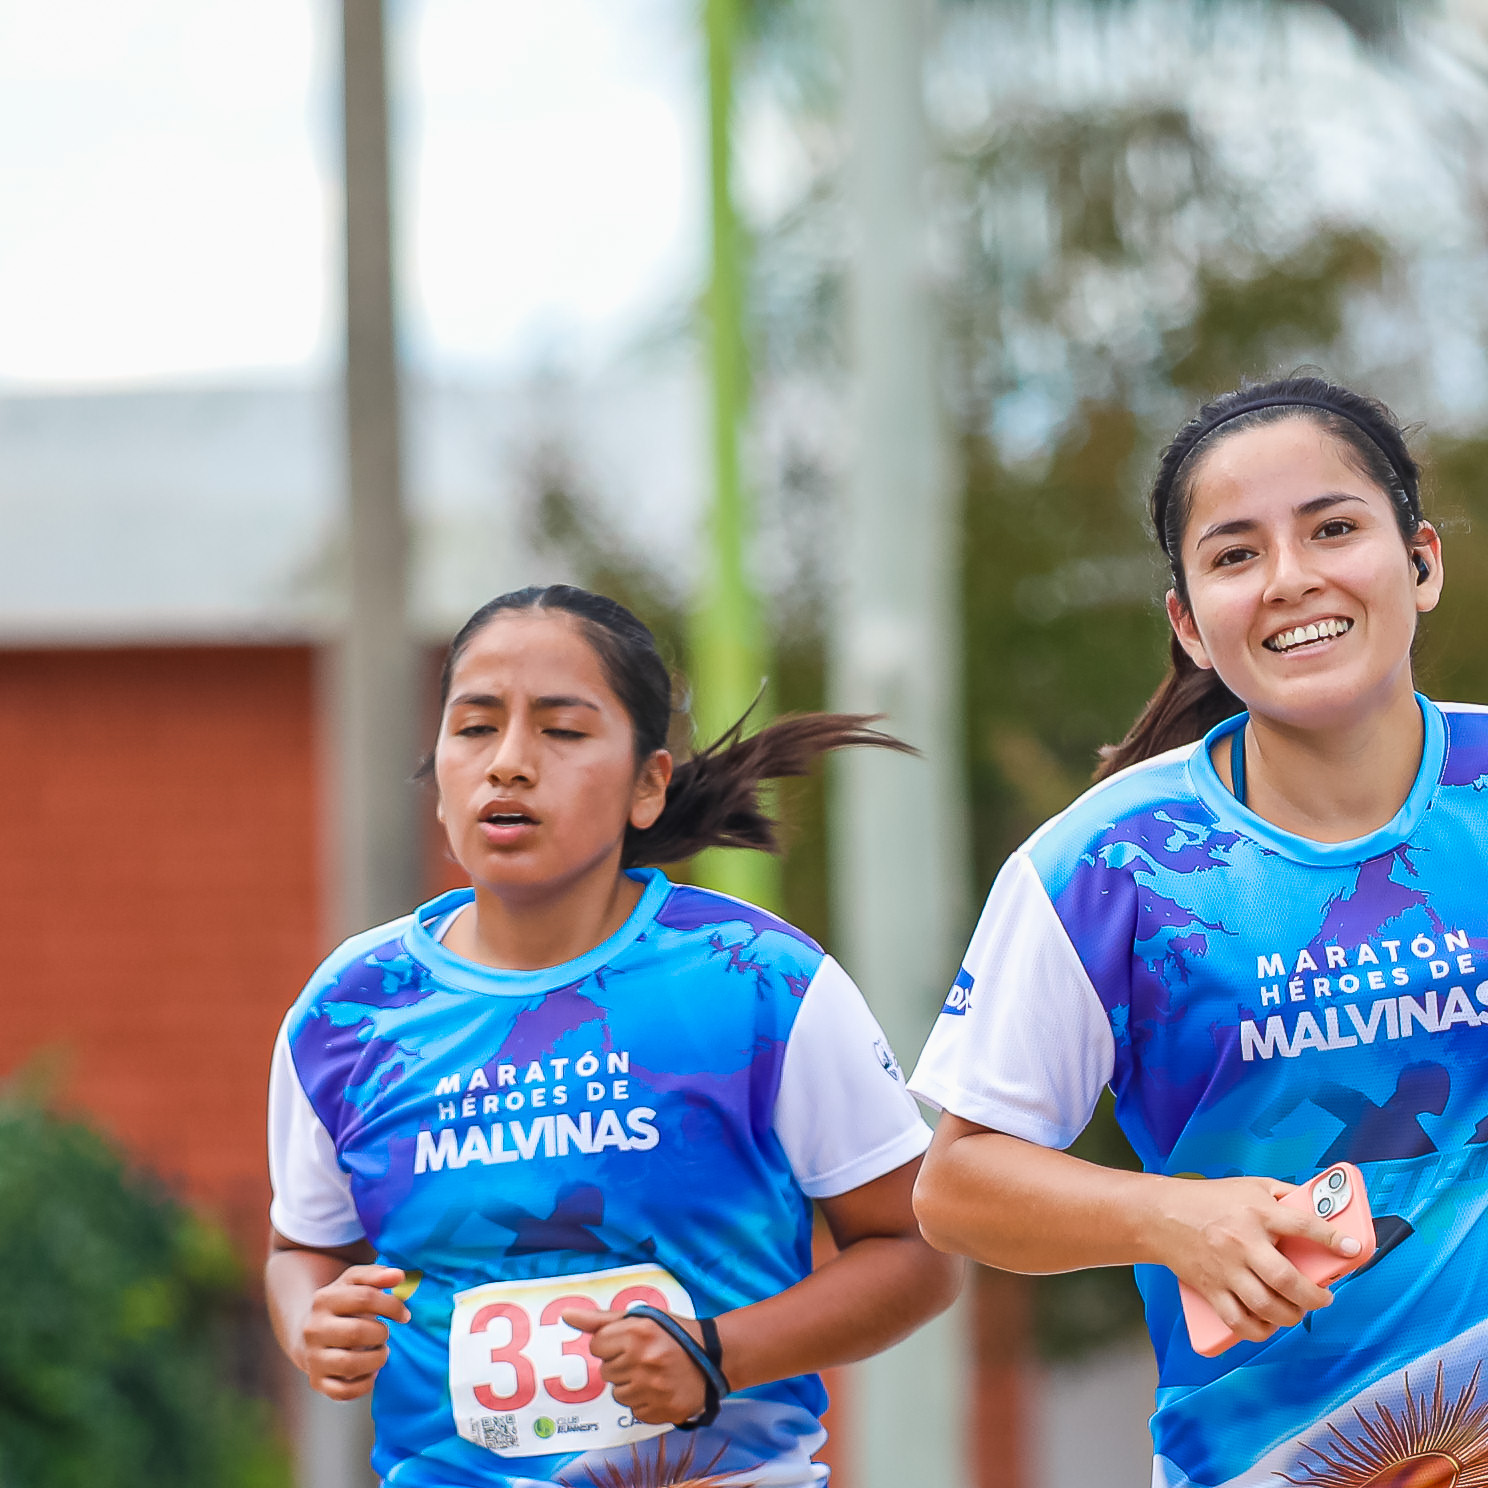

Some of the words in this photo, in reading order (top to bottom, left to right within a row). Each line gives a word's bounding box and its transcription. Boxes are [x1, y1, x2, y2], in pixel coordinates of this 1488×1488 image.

[1257, 929, 1471, 979] MARATÓN
[1261, 967, 1410, 1007] HÉROES
[1429, 953, 1477, 980] DE
[434, 1051, 630, 1097] MARATÓN
[438, 1084, 568, 1121] HÉROES
[587, 1080, 630, 1101] DE
[413, 1106, 660, 1175] MALVINAS
[469, 1284, 671, 1412] 33
